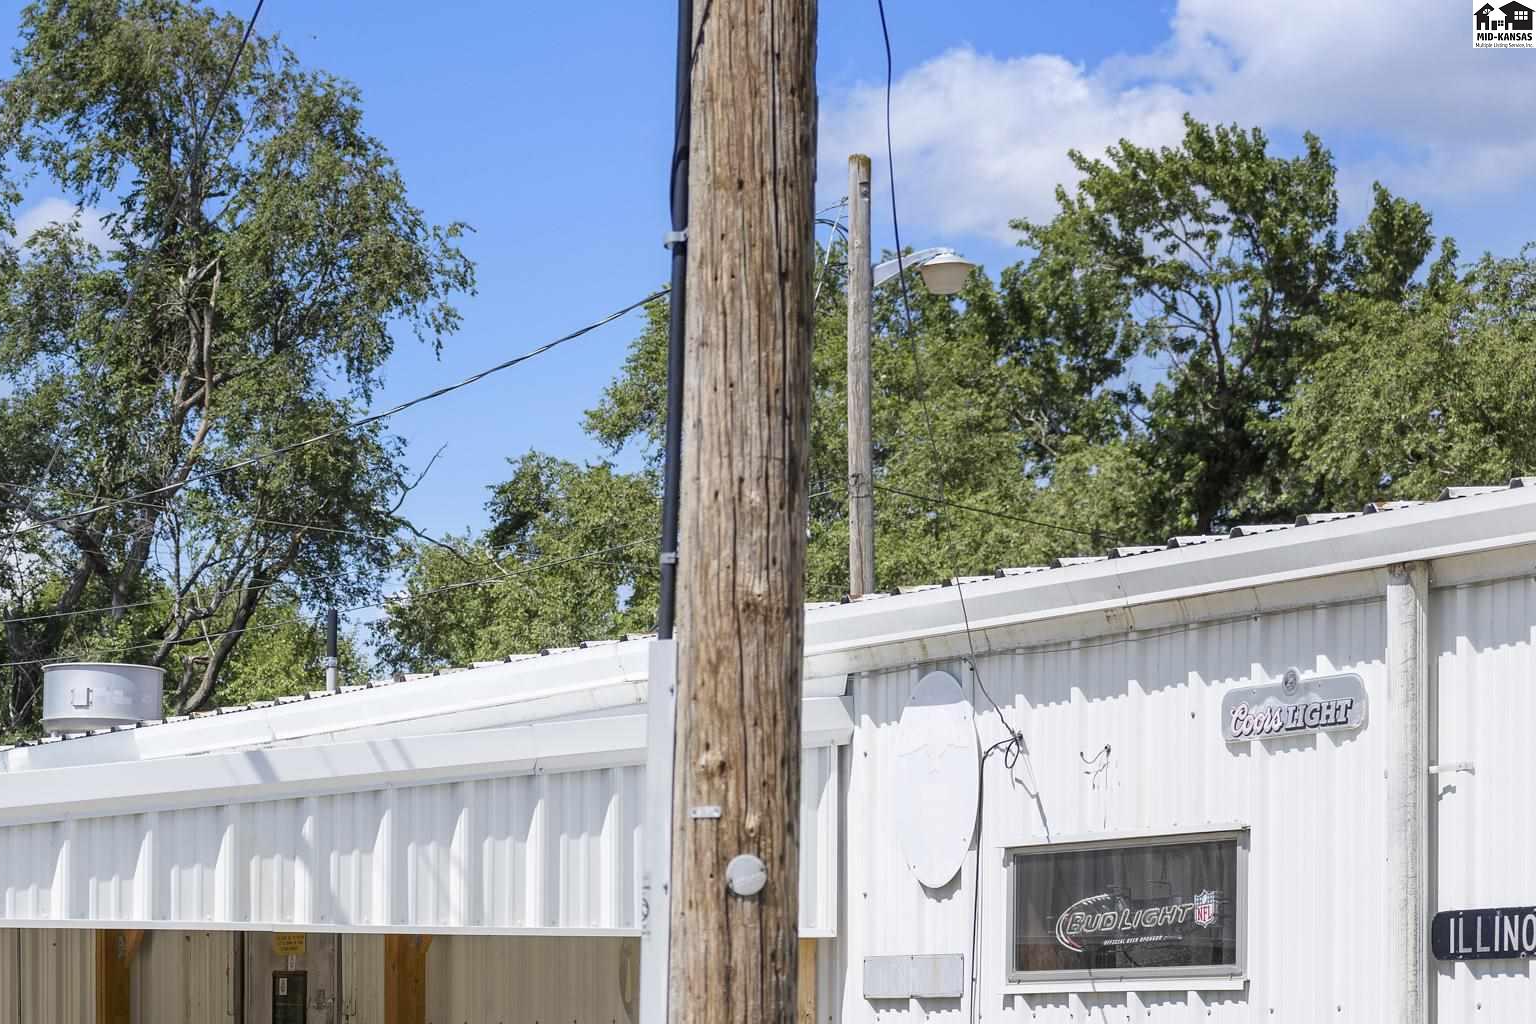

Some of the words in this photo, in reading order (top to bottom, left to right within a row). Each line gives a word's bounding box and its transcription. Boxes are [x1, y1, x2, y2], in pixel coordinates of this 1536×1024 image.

[1230, 702, 1284, 738] Coors
[1285, 698, 1353, 731] LIGHT
[1119, 902, 1195, 931] LIGHT
[1196, 904, 1212, 922] NFL
